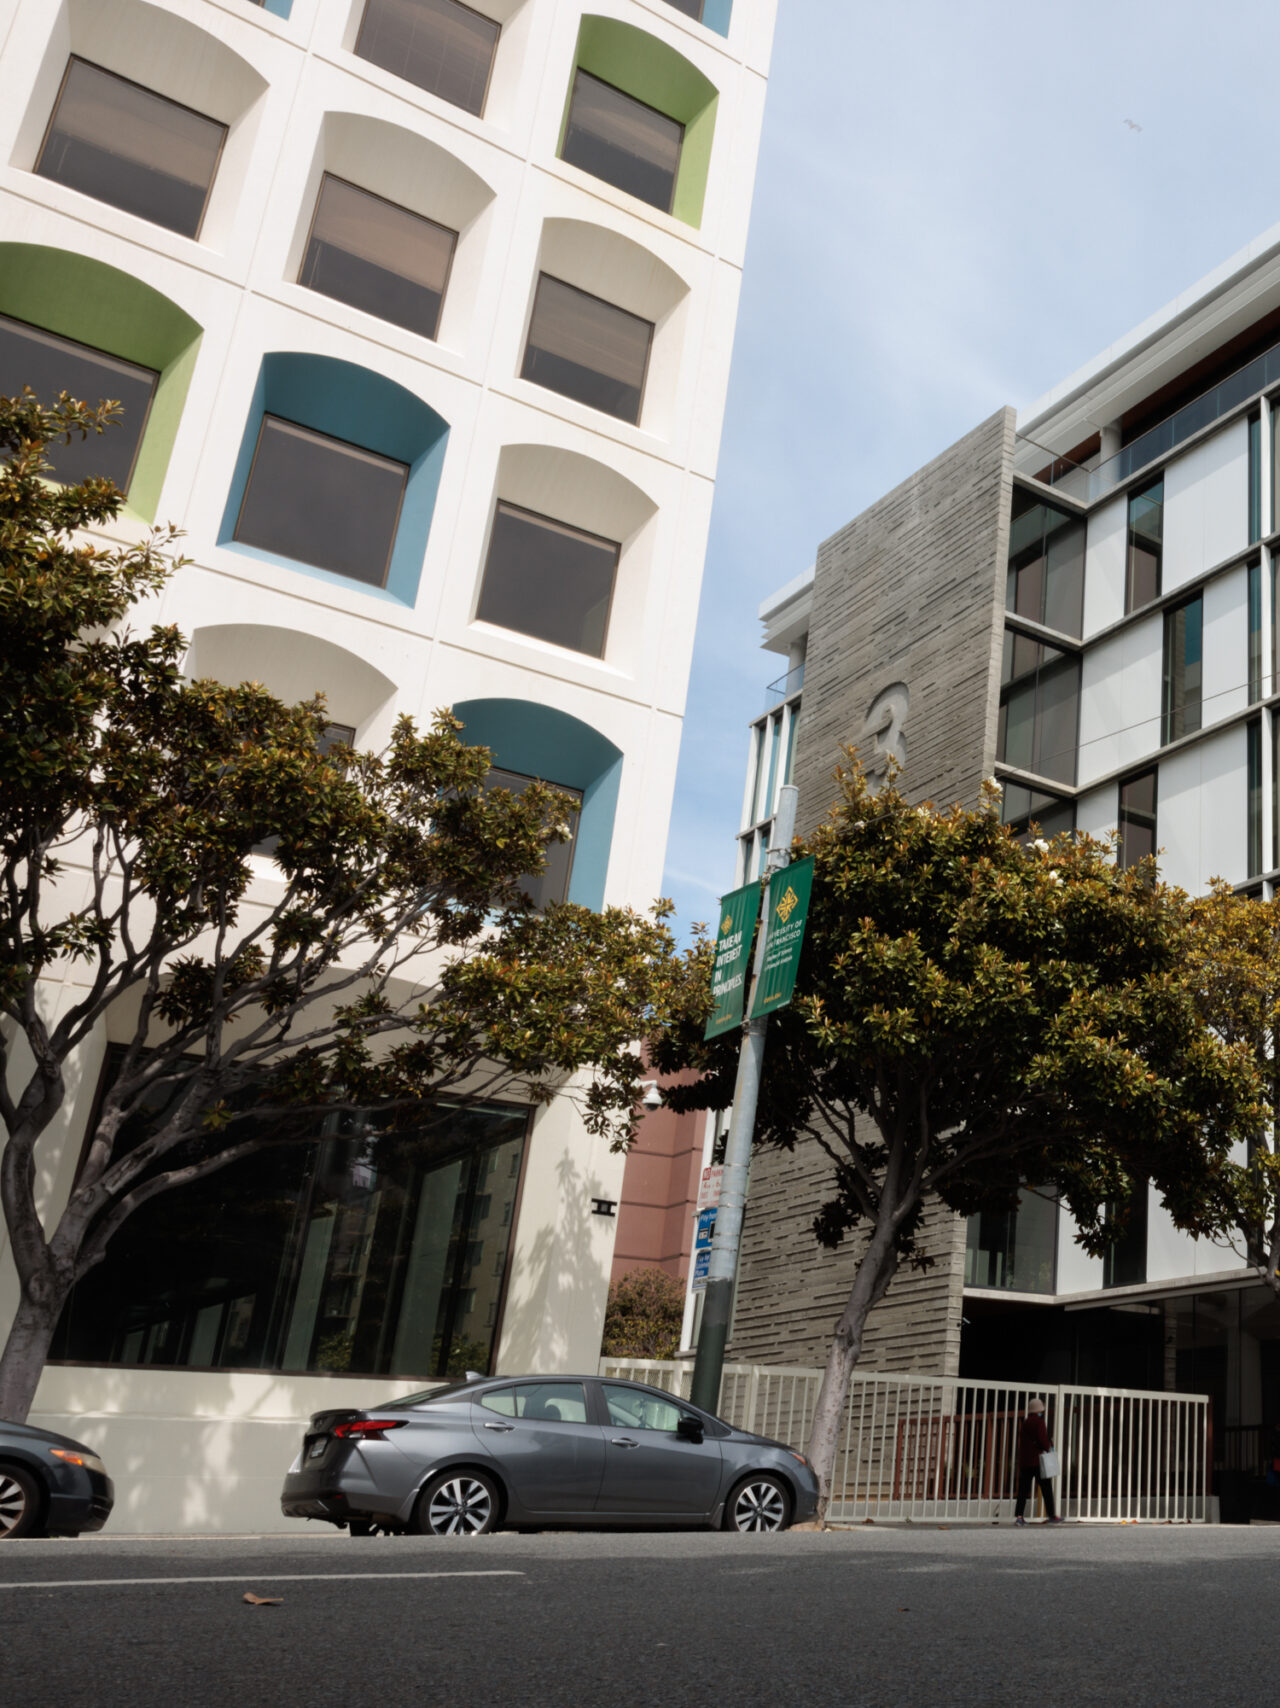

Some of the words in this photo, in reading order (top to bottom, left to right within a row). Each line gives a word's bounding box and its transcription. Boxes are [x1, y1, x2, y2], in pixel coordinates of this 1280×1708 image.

[794, 919, 803, 929] OF
[716, 944, 743, 968] INTEREST
[712, 973, 743, 997] PRINCIPLES
[714, 970, 722, 983] IN
